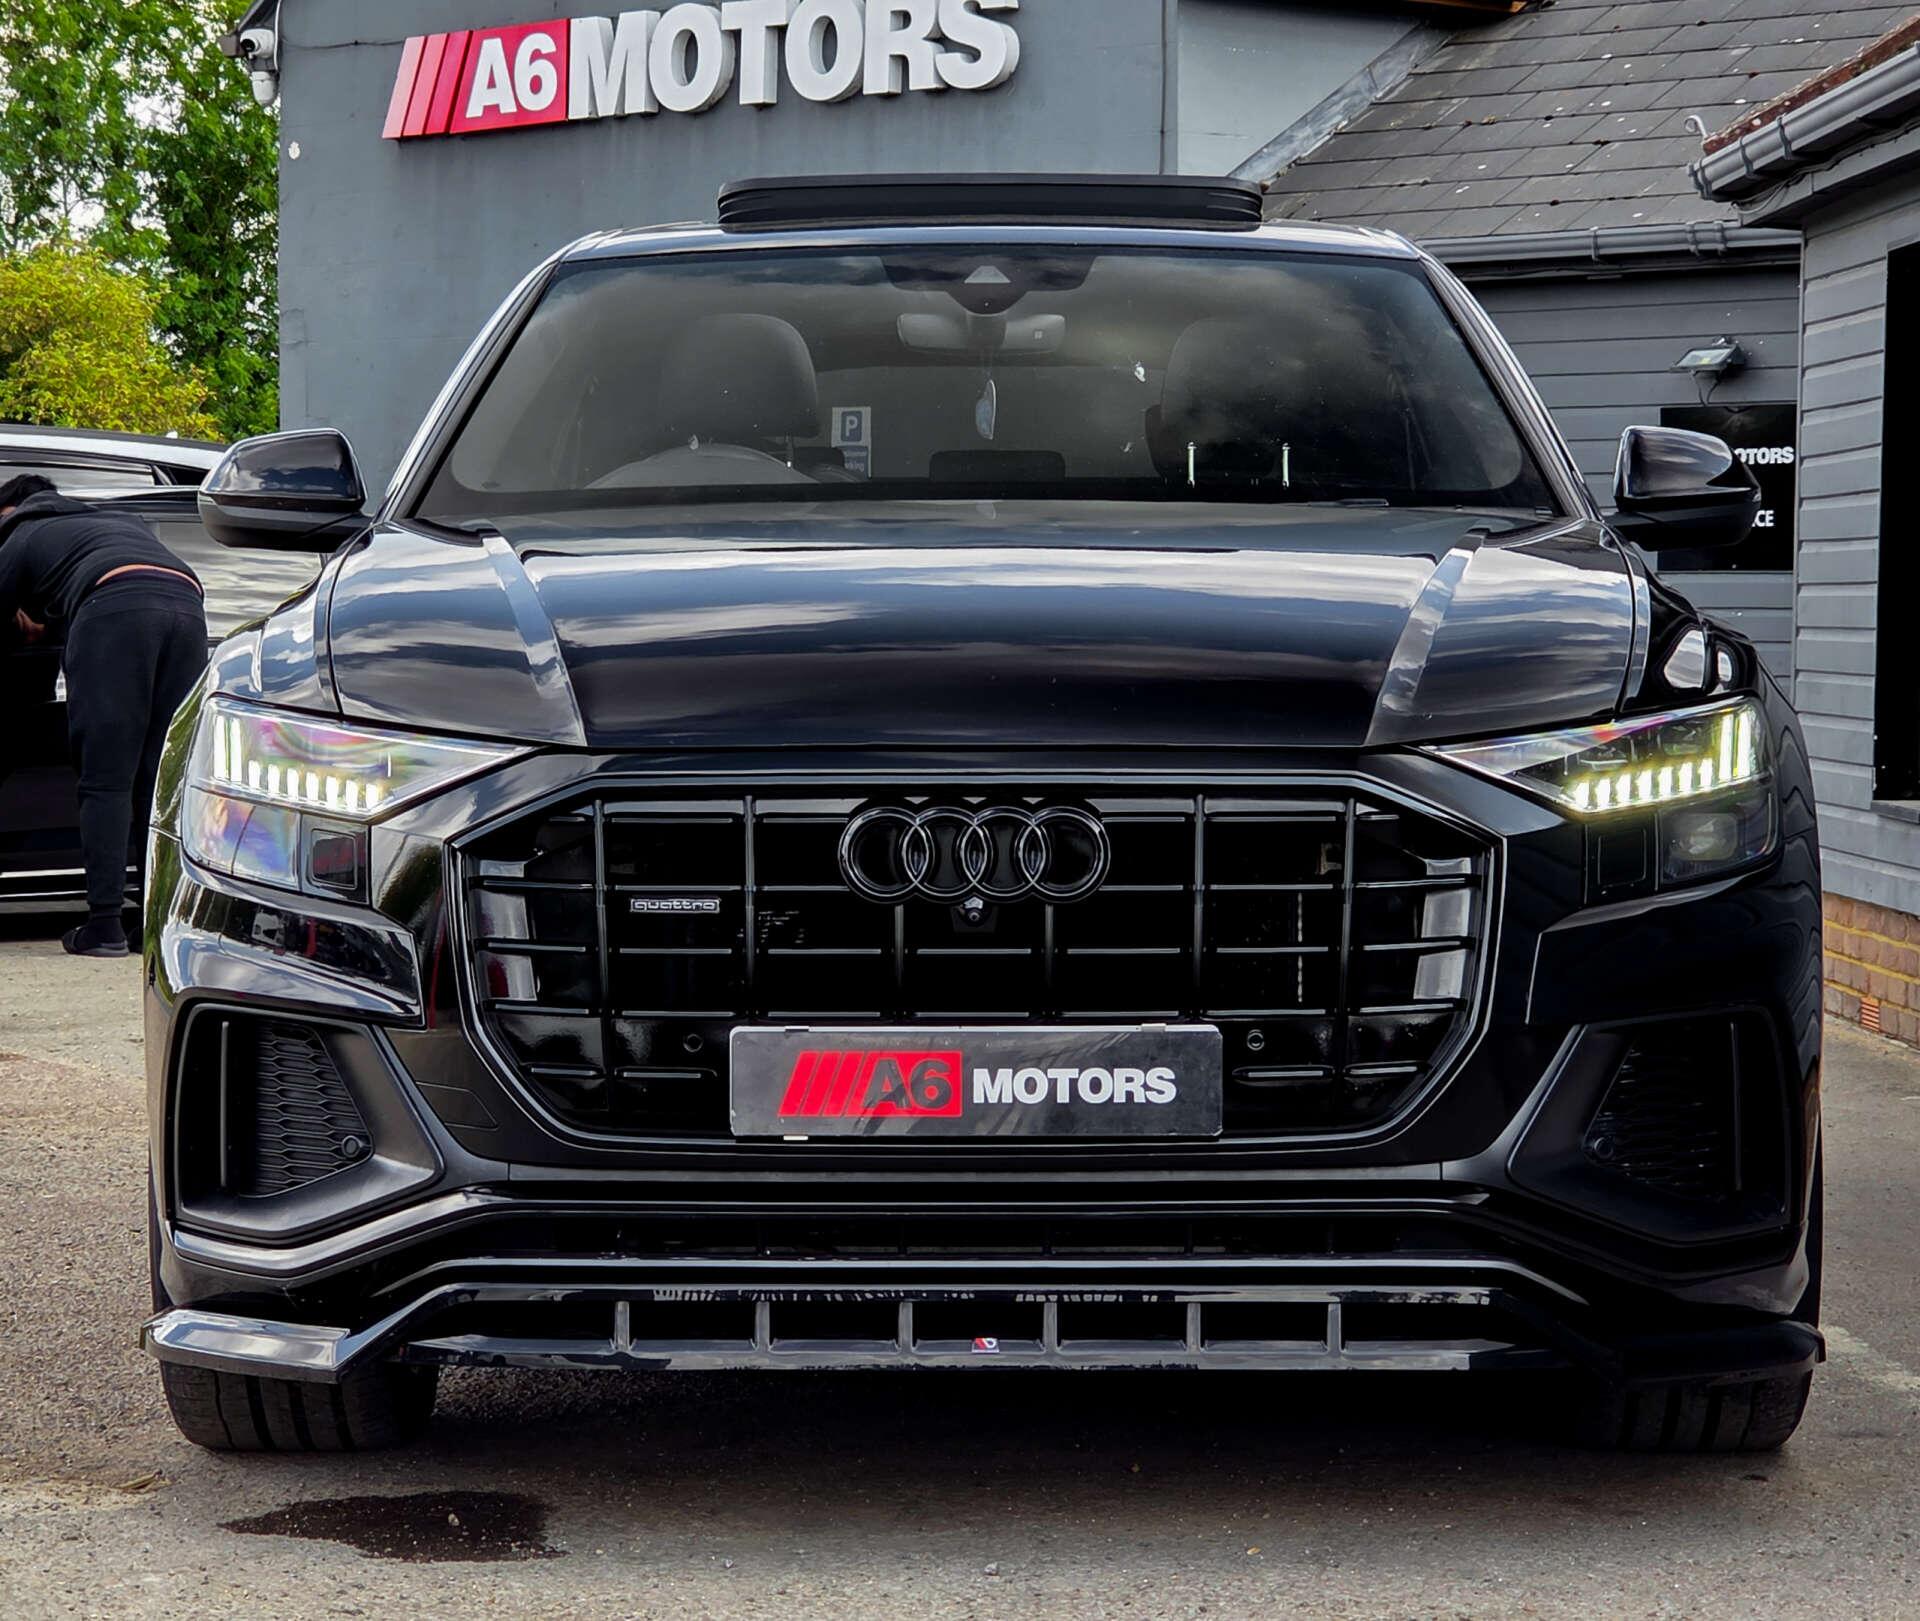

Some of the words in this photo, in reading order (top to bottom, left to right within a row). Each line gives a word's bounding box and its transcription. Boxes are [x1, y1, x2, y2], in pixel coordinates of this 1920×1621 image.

[465, 32, 558, 119] A6
[568, 0, 1020, 120] MOTORS
[845, 415, 859, 437] P
[1733, 446, 1795, 465] OTORS
[634, 900, 716, 911] quattro
[861, 1057, 953, 1110] A6
[972, 1067, 1177, 1105] MOTORS
